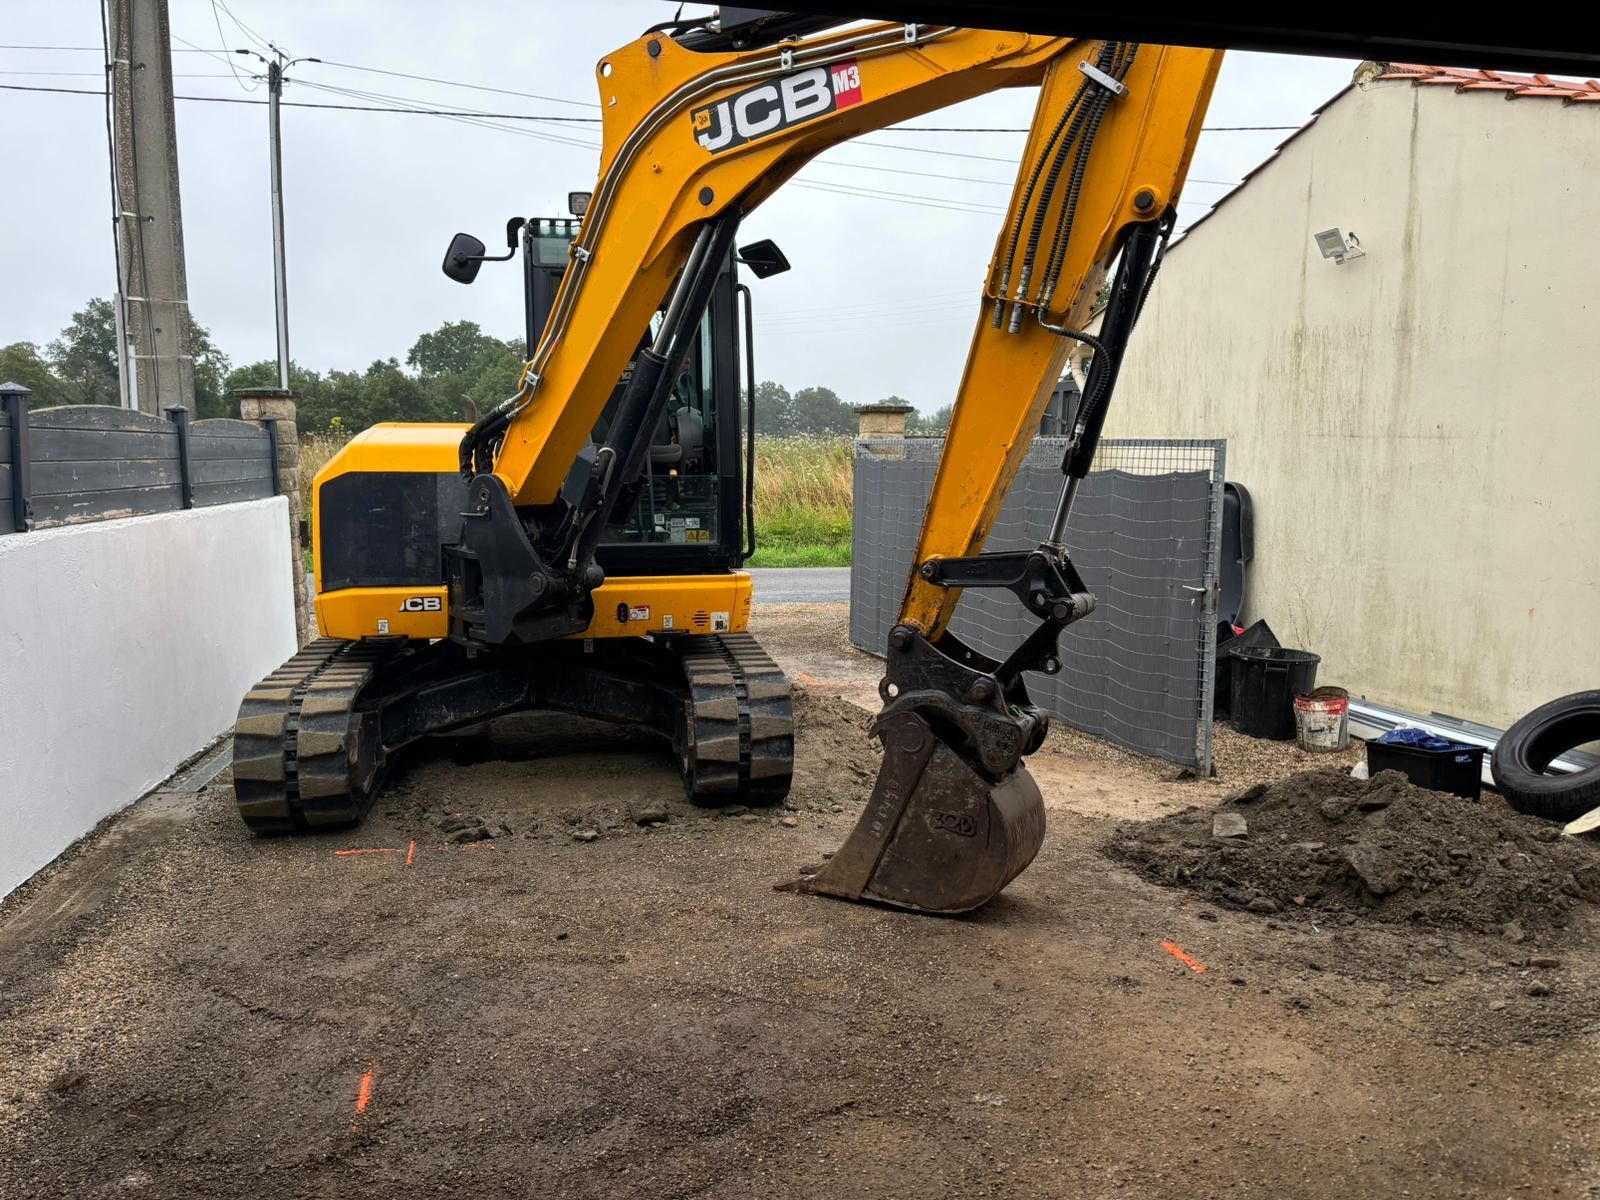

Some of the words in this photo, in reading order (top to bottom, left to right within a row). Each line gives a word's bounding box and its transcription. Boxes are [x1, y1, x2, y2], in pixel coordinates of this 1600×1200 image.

[698, 68, 832, 151] JCB
[831, 65, 861, 95] M3
[400, 597, 441, 612] JCB
